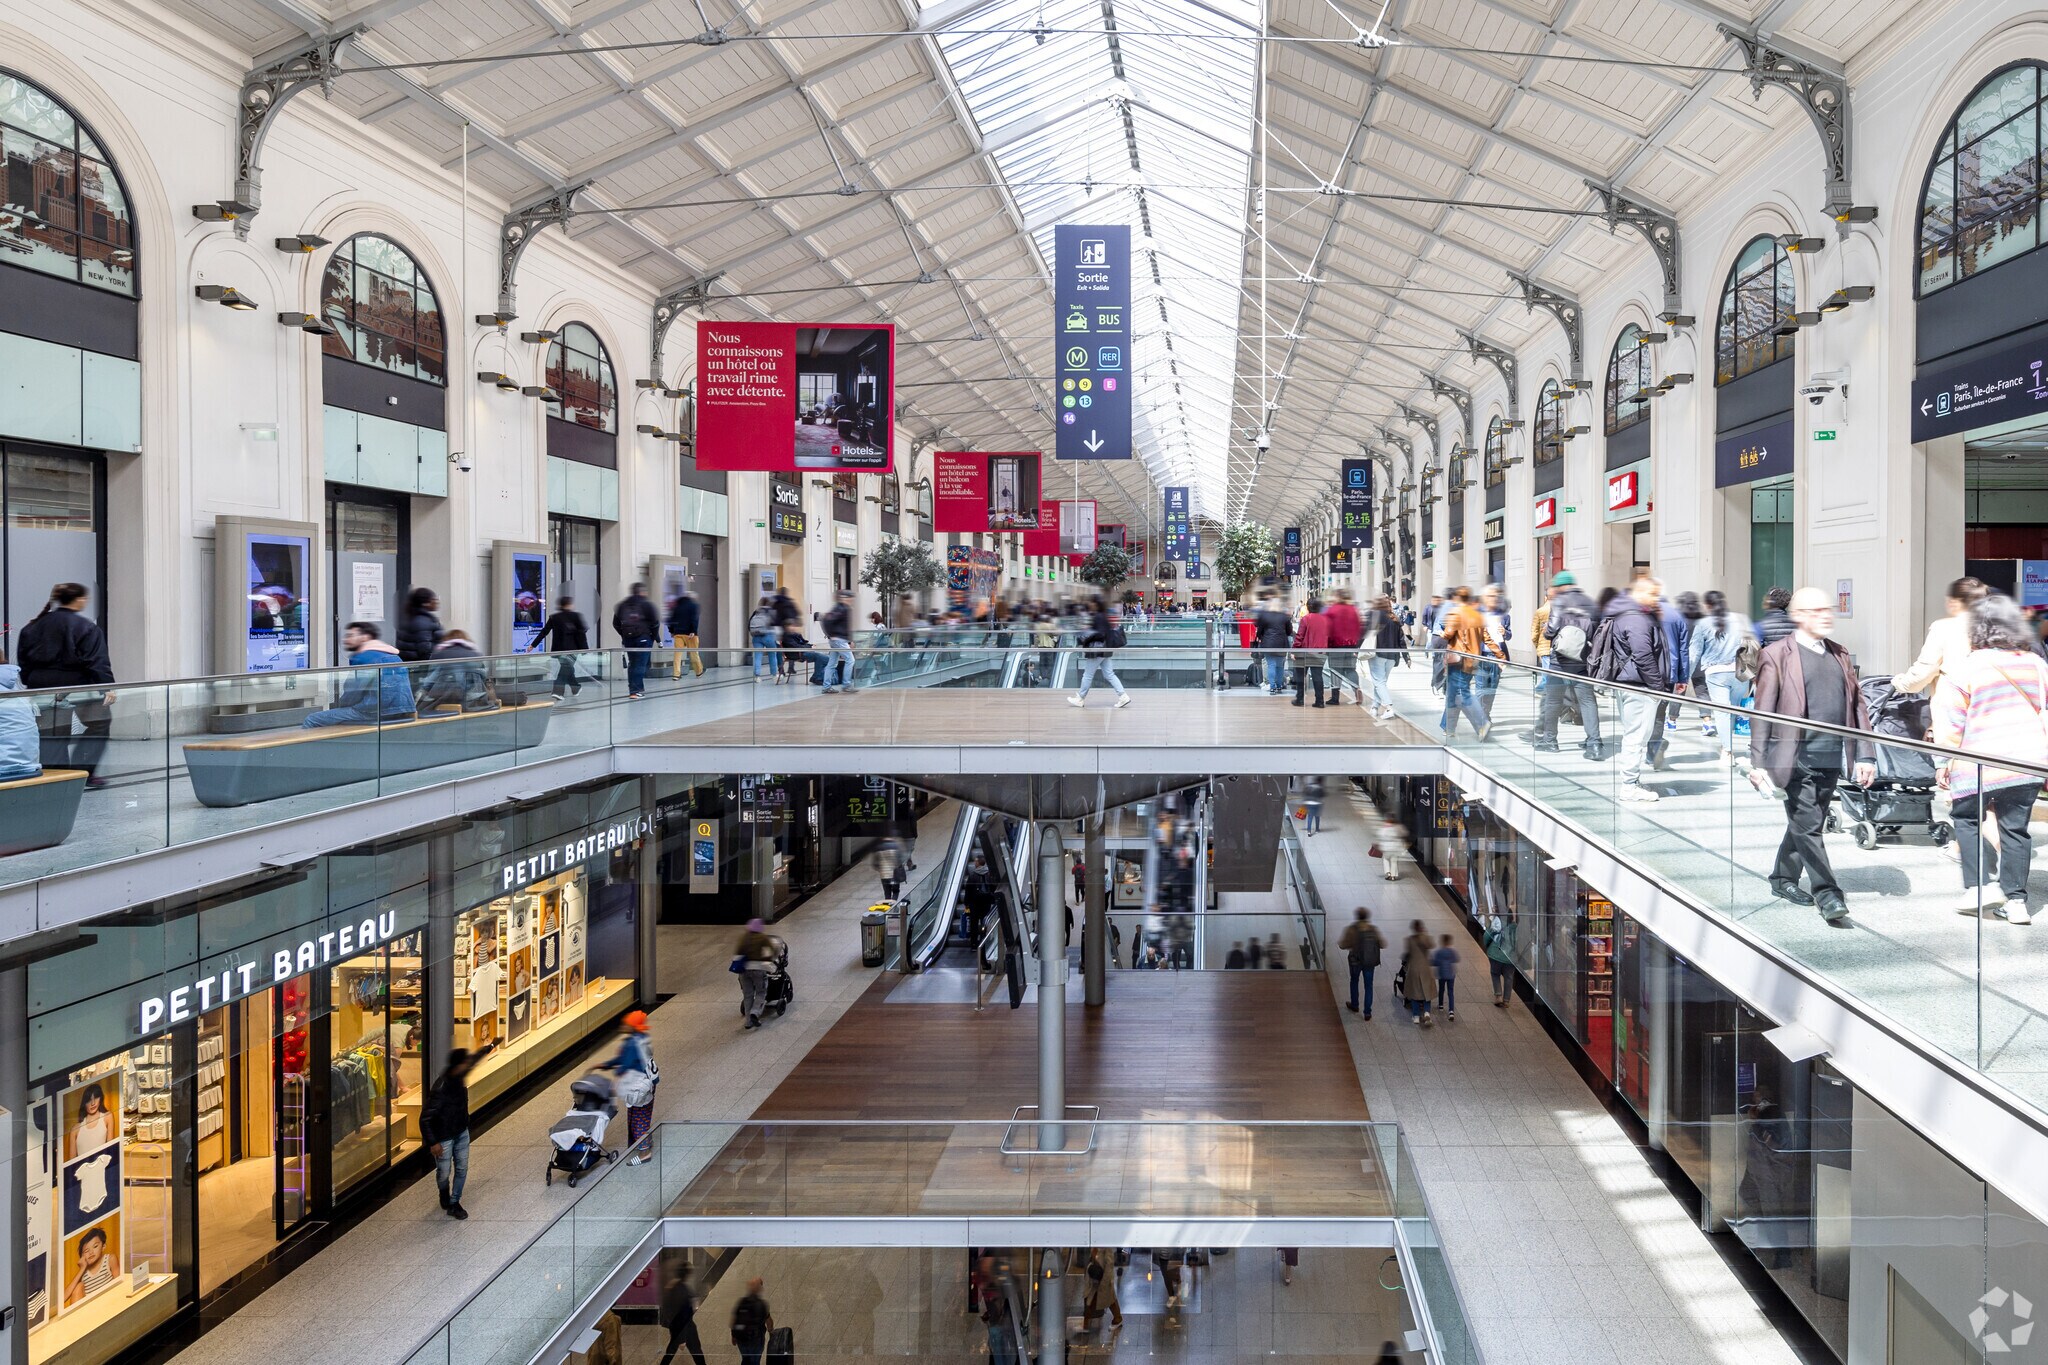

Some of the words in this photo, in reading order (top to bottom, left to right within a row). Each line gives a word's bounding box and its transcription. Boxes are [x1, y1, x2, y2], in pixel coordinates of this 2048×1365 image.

[88, 272, 104, 280] NEW
[108, 277, 126, 288] YORK
[1078, 273, 1108, 282] Sortie
[1930, 272, 1948, 284] SERVAN
[1099, 314, 1120, 325] BUS
[708, 331, 740, 343] Nous
[708, 346, 783, 358] connaissons
[1102, 353, 1117, 361] RER
[708, 361, 724, 370] un
[726, 358, 758, 370] hôtel
[760, 359, 776, 370] où
[708, 372, 747, 384] travail
[749, 373, 778, 384] rime
[2032, 370, 2040, 387] 1
[707, 387, 734, 396] avec
[736, 384, 786, 397] détente.
[1954, 383, 1968, 391] Trains
[1954, 390, 1972, 402] Paris,
[1974, 377, 2023, 398] Île-de-France
[776, 485, 798, 506] Sortie
[1484, 520, 1501, 539] PAUL
[848, 804, 862, 814] 12
[872, 803, 886, 814] 21
[503, 849, 558, 890] PETIT
[565, 824, 626, 866] BATEAU
[140, 962, 256, 1034] PETIT
[272, 910, 395, 982] BATEAU
